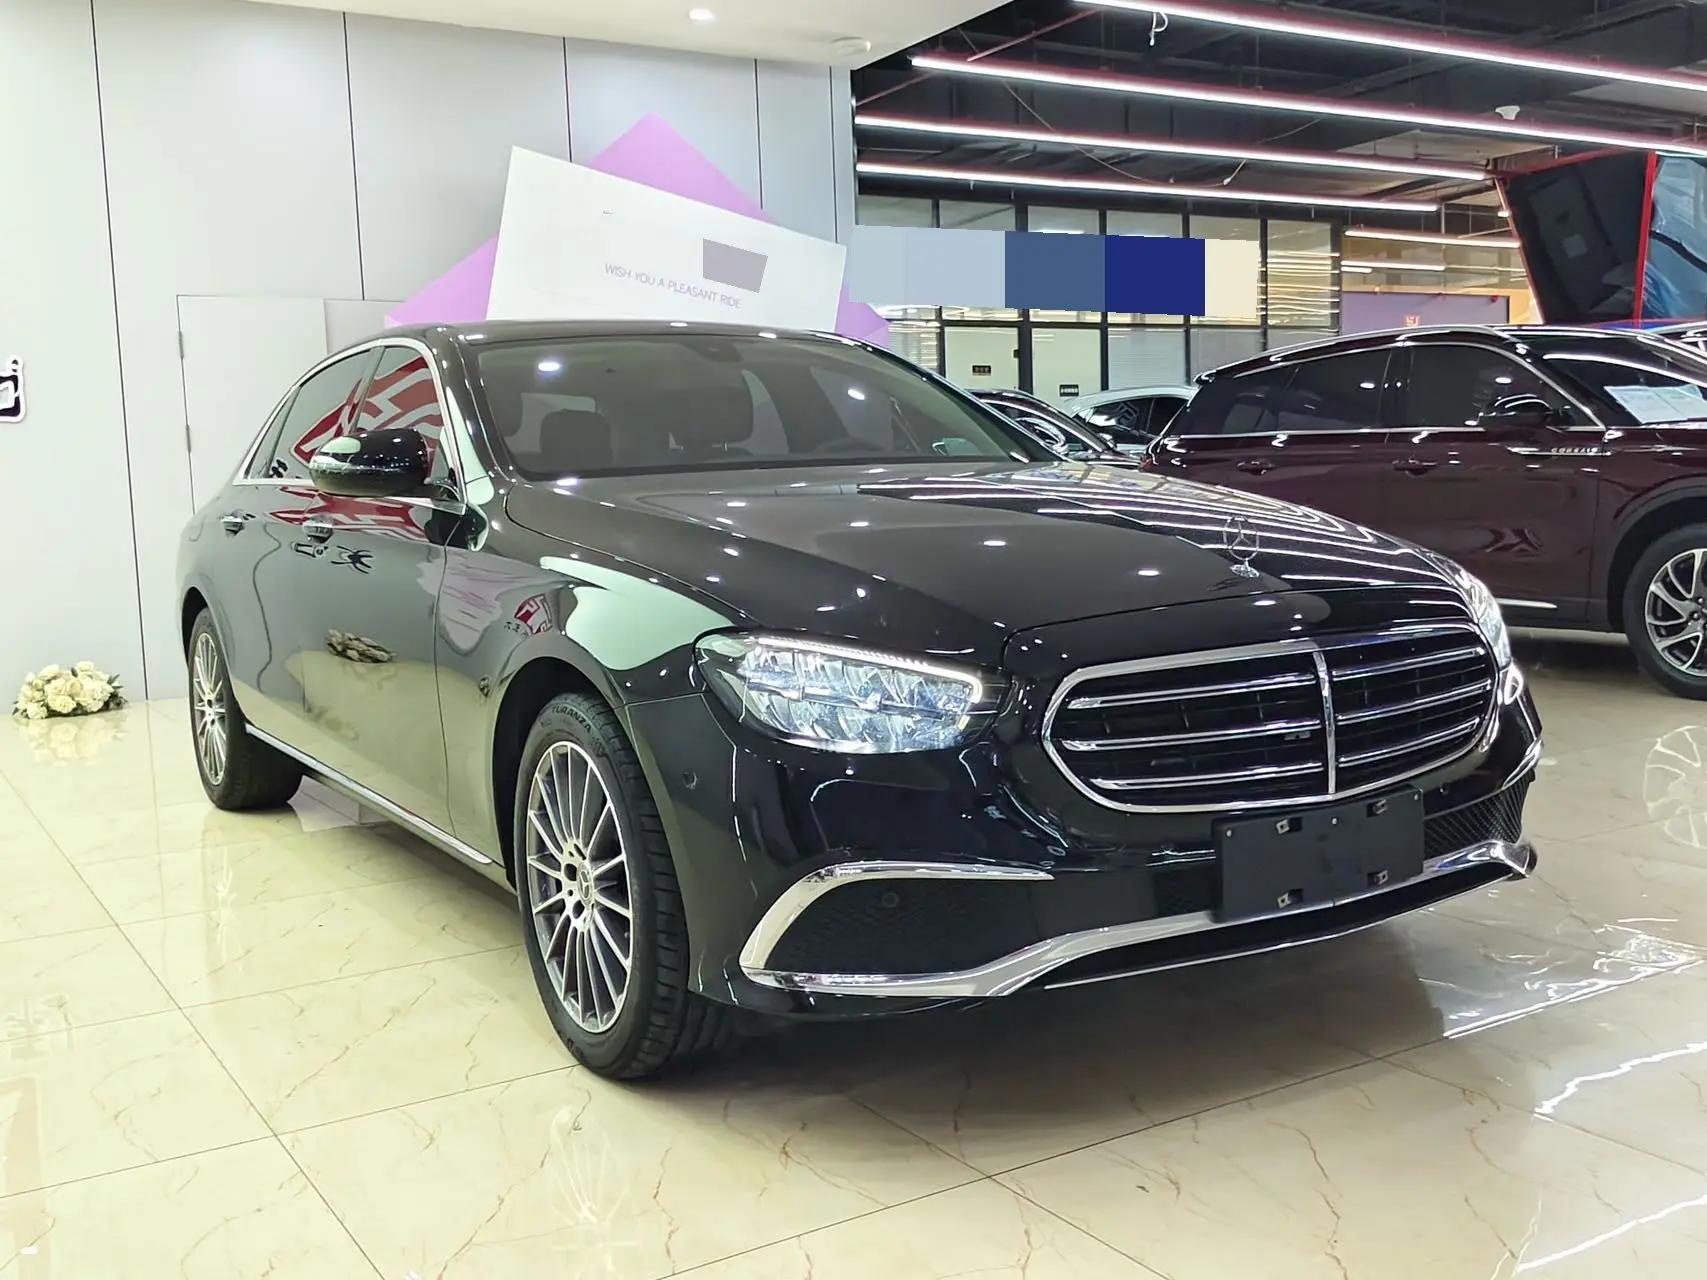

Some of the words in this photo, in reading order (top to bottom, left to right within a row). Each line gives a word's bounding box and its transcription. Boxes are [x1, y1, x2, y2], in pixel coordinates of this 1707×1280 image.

[605, 263, 631, 278] WISH
[635, 271, 655, 286] YOU
[657, 277, 666, 287] A
[668, 280, 719, 302] PLEASANT
[720, 294, 743, 308] RIDE
[552, 704, 592, 733] TURANZA
